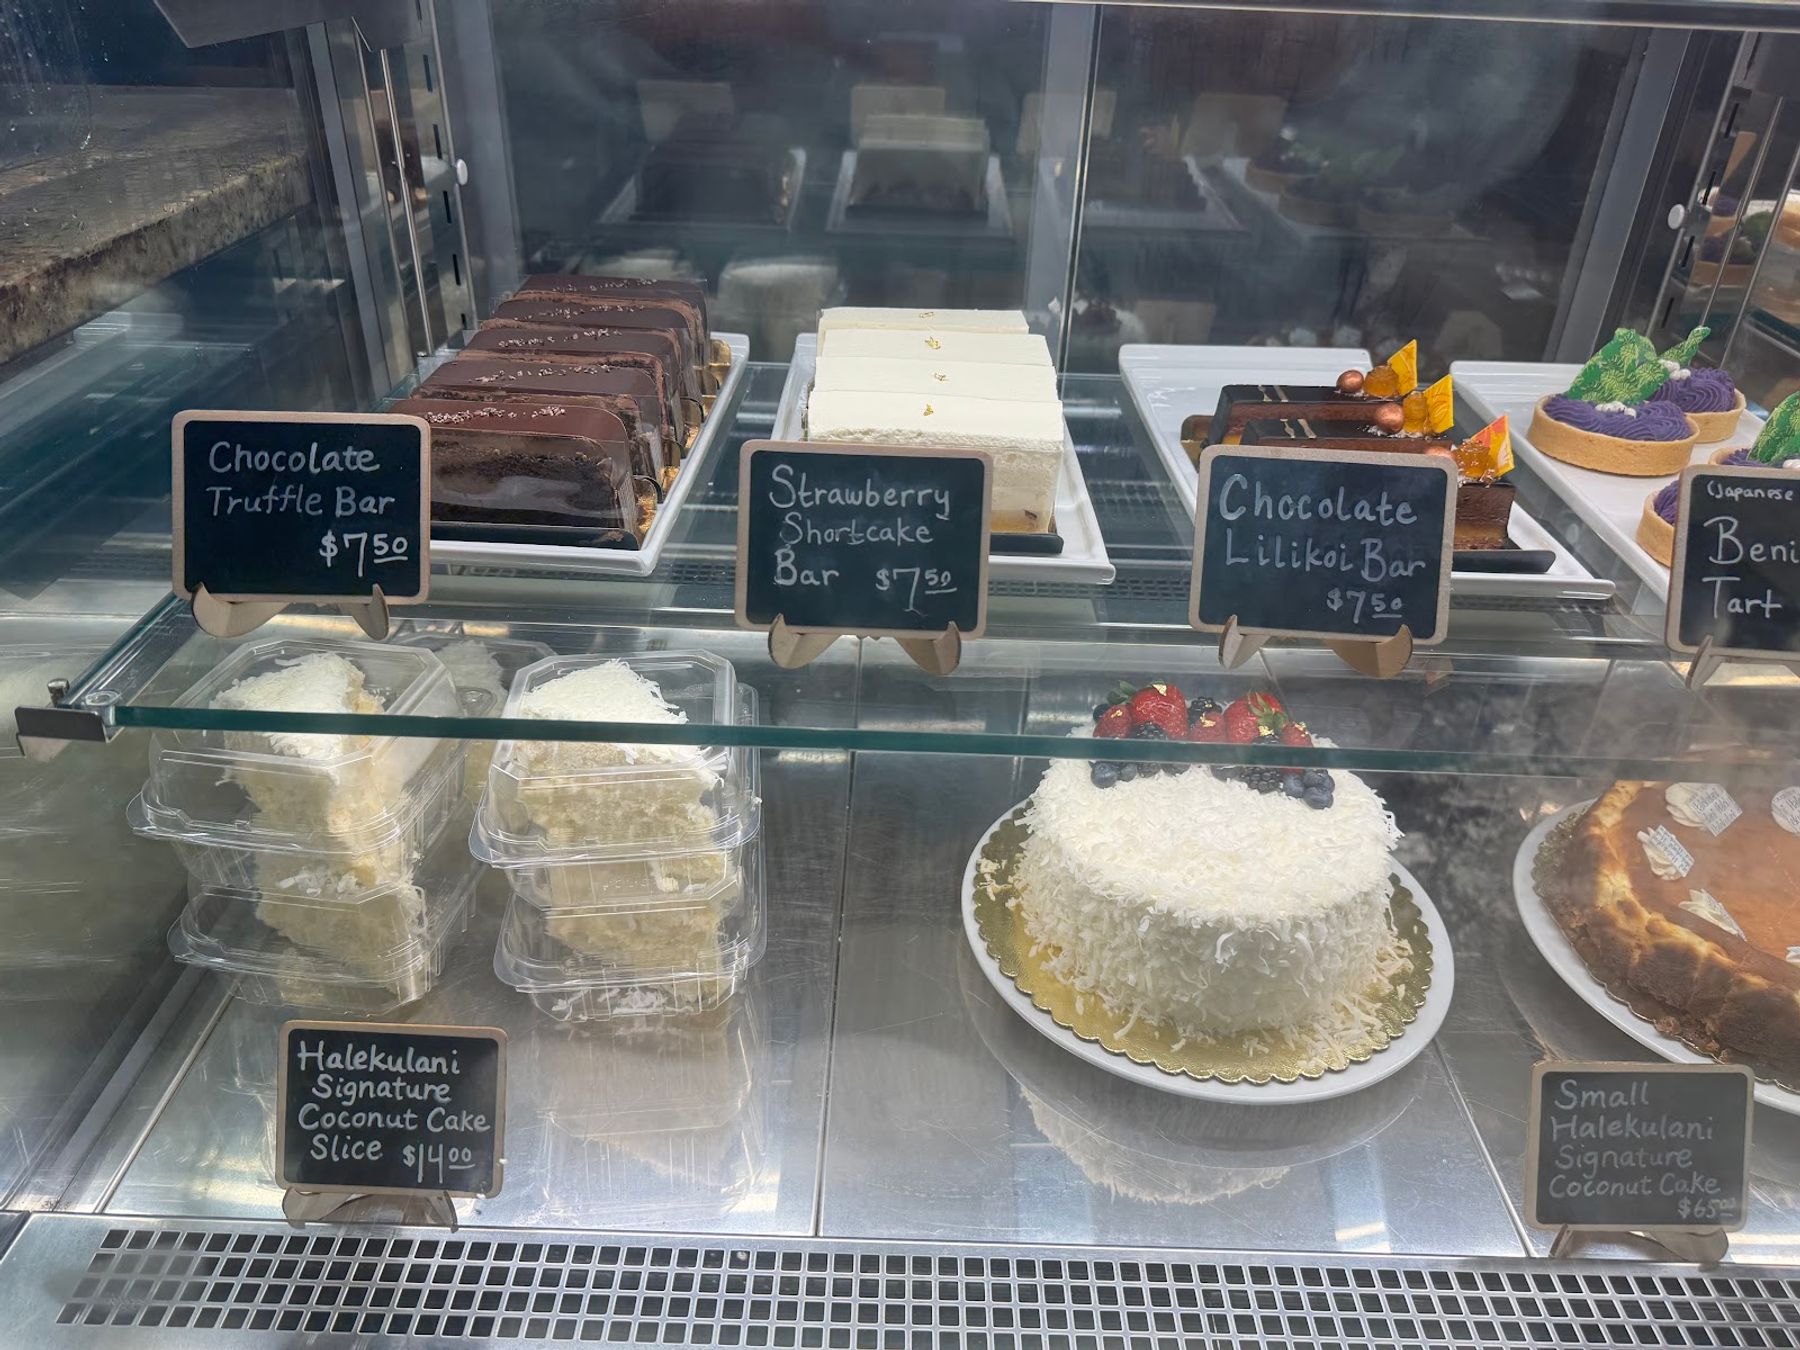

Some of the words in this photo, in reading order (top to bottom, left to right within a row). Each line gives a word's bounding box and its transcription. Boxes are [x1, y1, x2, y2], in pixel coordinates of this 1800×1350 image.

[208, 441, 380, 474] Chocolate
[206, 484, 323, 516] Truffle
[335, 486, 395, 518] Bar
[769, 464, 950, 520] Strawberry
[1219, 473, 1418, 526] Chocolate
[1707, 480, 1794, 501] (Japanese
[779, 512, 934, 546] Shortcake
[1703, 516, 1800, 564] Beni
[773, 546, 839, 586] Bar
[1226, 528, 1353, 572] Lilikoi
[1360, 538, 1426, 582] Bar
[1702, 577, 1782, 619] Tart
[297, 1040, 460, 1074] Halekulani
[312, 1074, 452, 1106] Signature
[1554, 1079, 1649, 1110] Small
[298, 1103, 418, 1131] Coconut
[426, 1107, 491, 1133] Cake
[1550, 1112, 1713, 1142] Halekulani
[310, 1134, 383, 1162] Slice
[1555, 1144, 1693, 1179] Signature
[1549, 1174, 1652, 1198] Coconut
[1659, 1171, 1721, 1196] Cake
